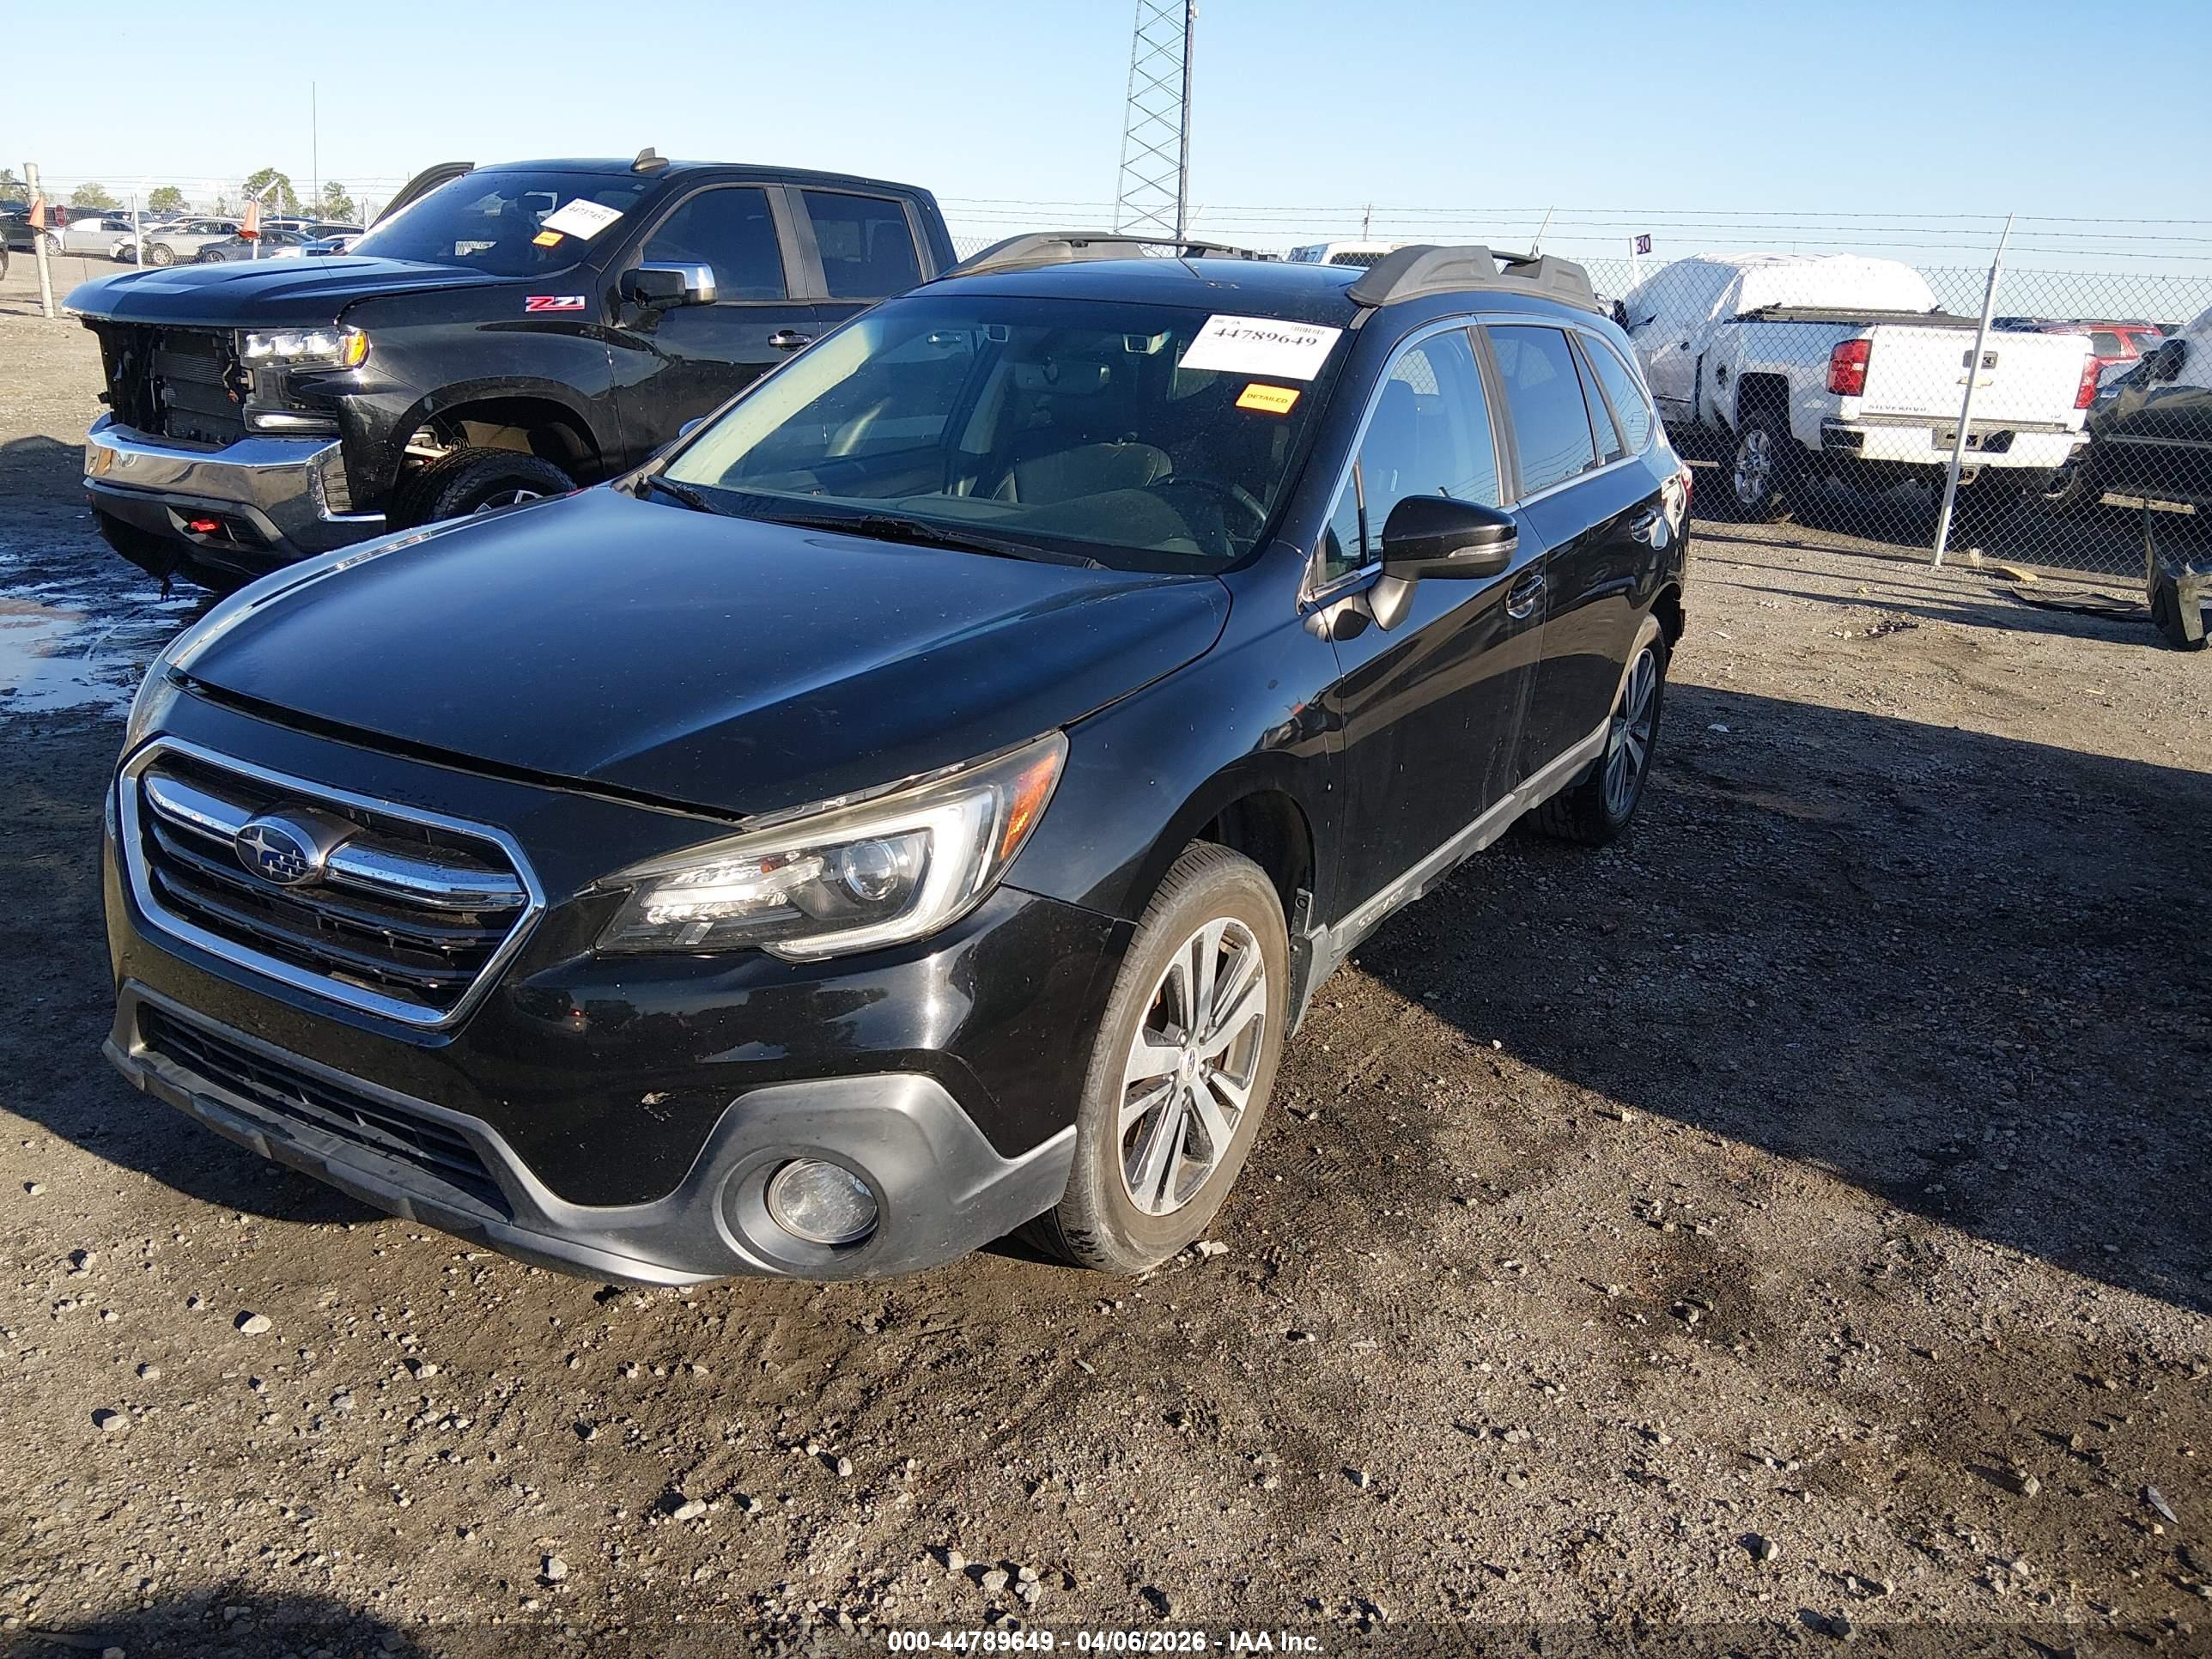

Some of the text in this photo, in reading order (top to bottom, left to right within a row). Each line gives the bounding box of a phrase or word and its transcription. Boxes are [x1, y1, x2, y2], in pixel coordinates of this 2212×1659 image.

[1635, 235, 1651, 255] 30
[525, 295, 586, 313] Z71
[1212, 328, 1317, 347] 44789649
[1246, 392, 1289, 404] DETAILED
